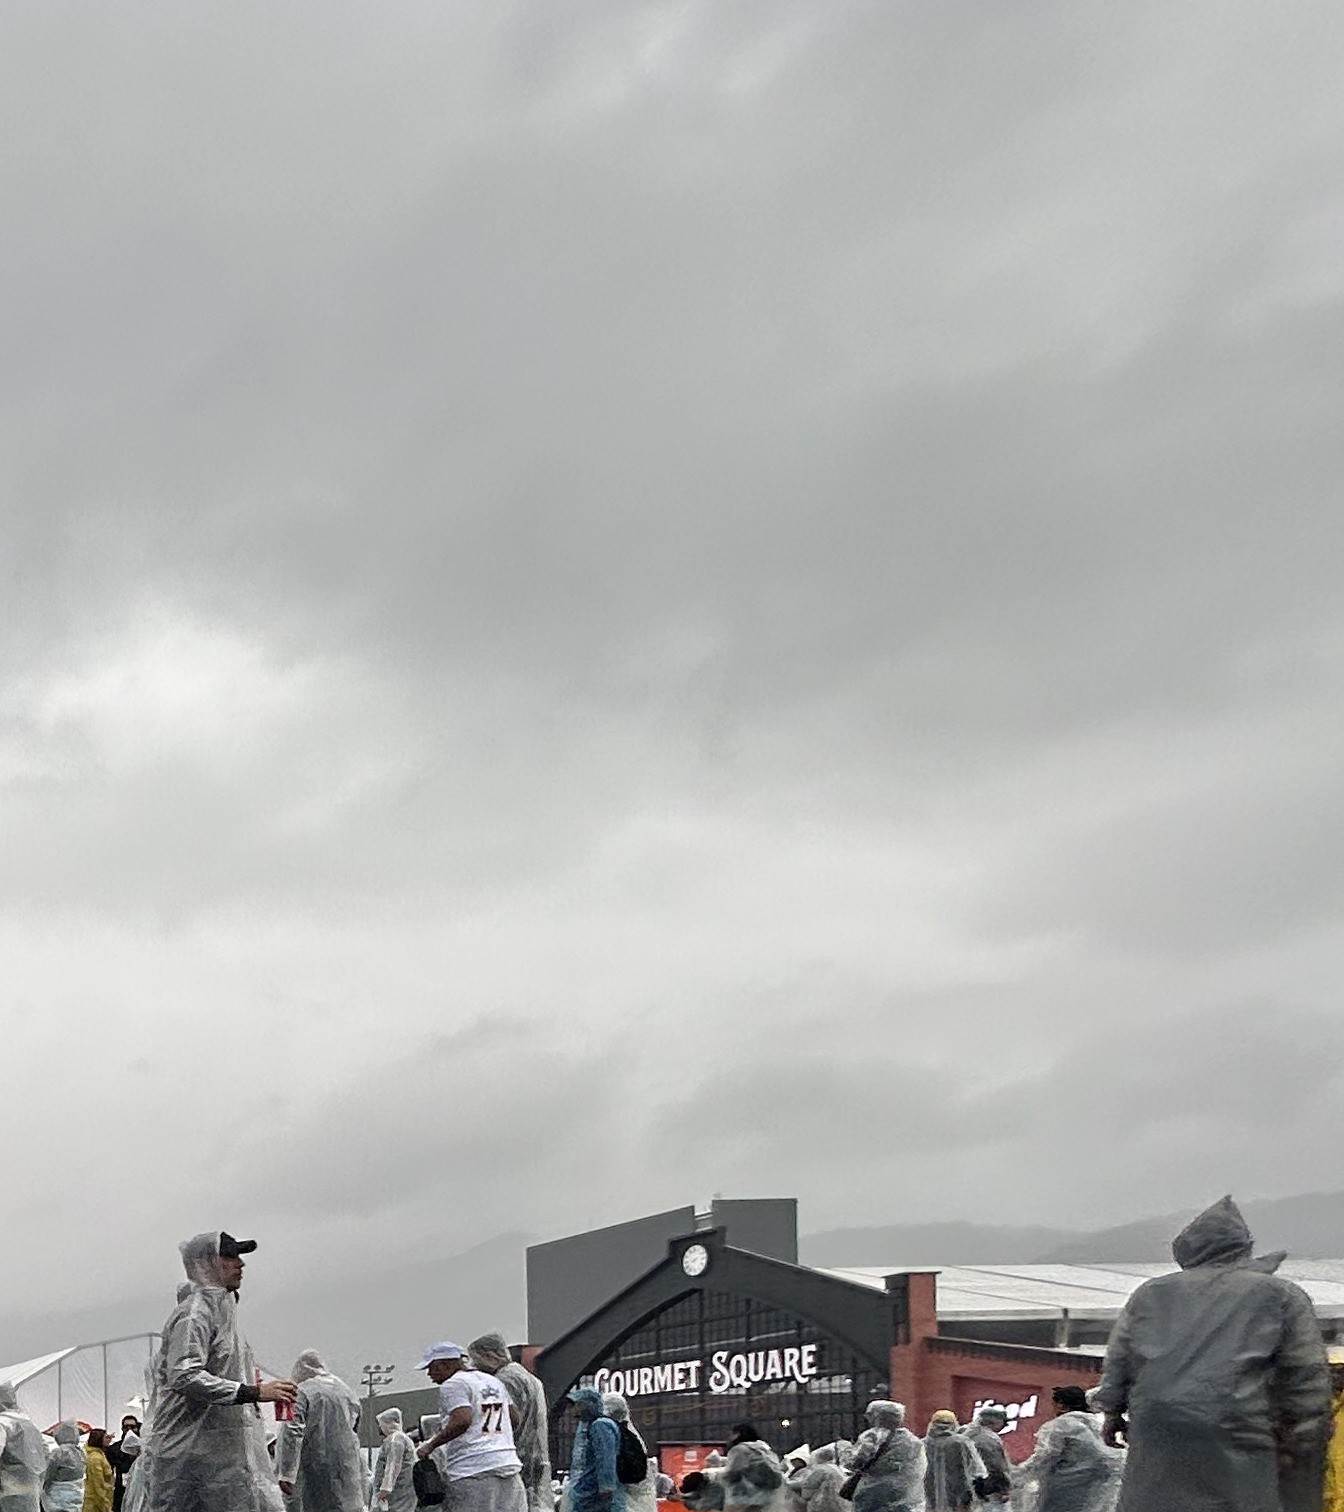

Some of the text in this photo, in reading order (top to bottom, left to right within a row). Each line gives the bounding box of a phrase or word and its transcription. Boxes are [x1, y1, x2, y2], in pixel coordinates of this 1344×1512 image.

[594, 1344, 817, 1398] GOURMET SQUARE
[481, 1403, 503, 1433] 77
